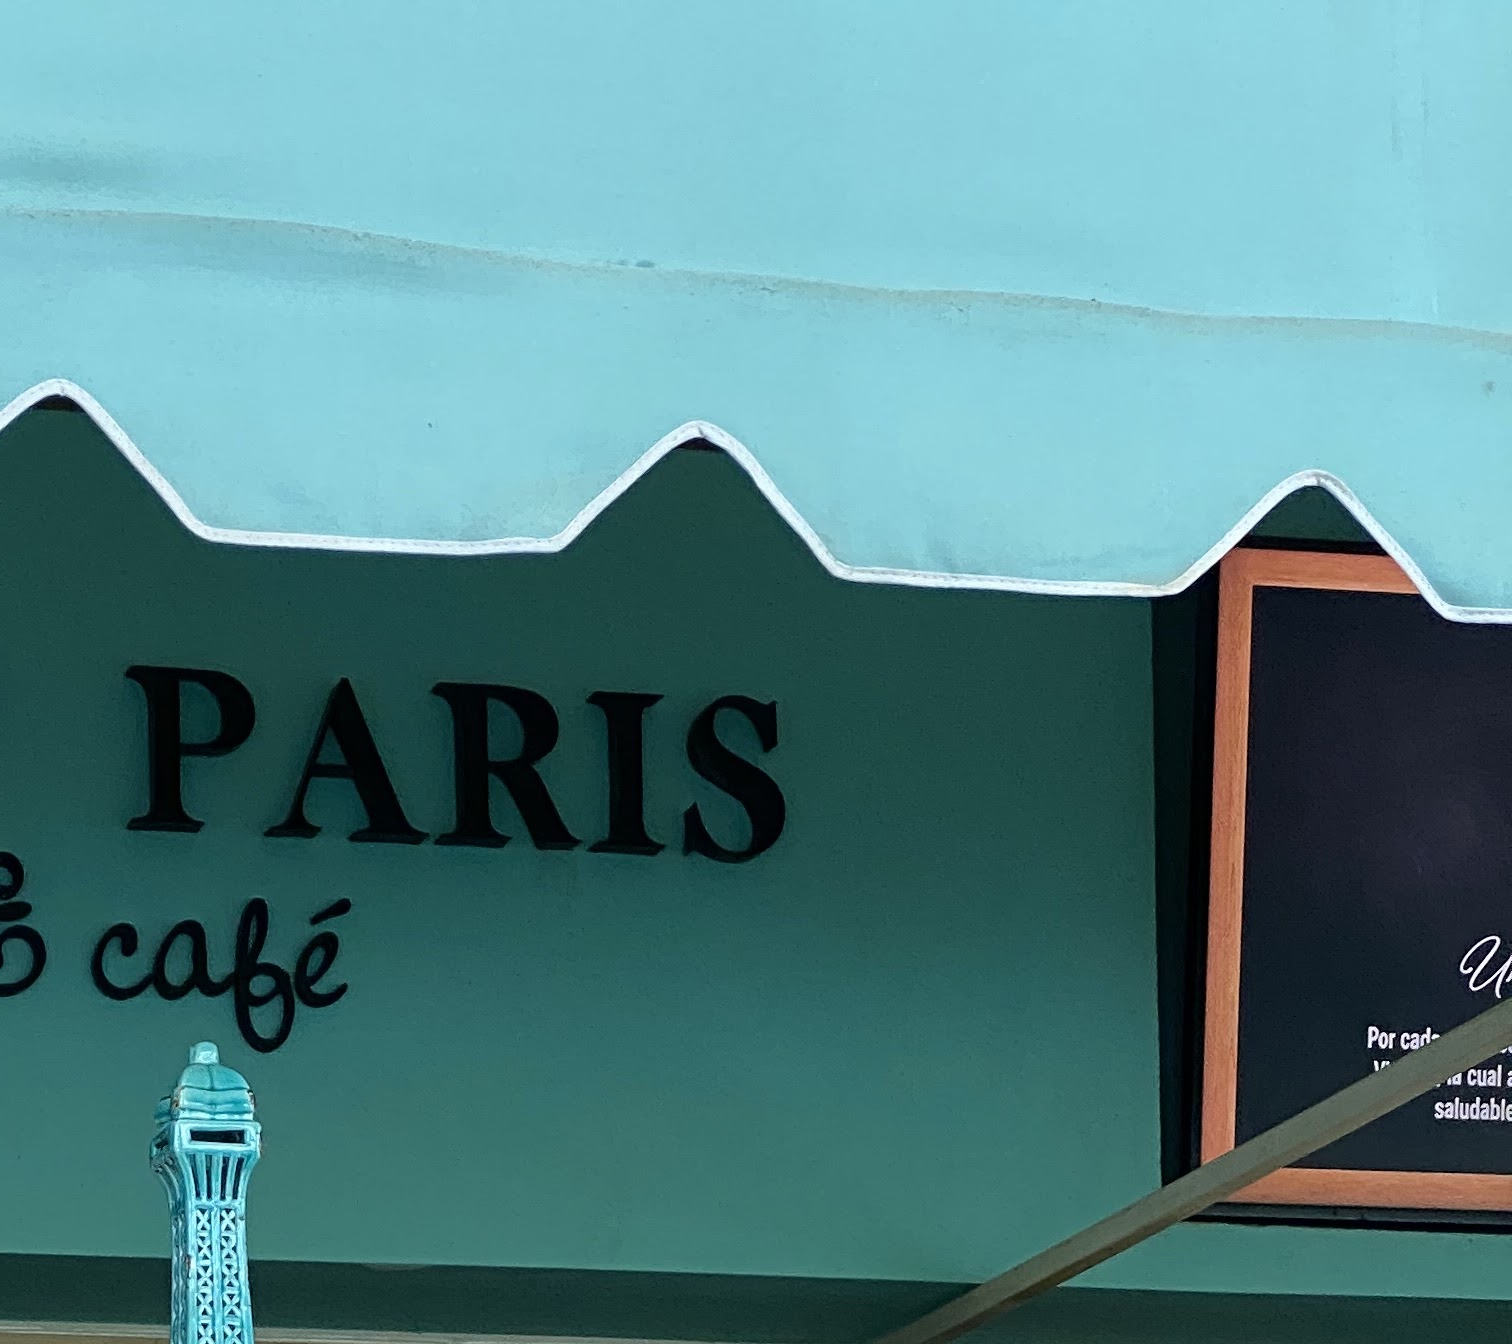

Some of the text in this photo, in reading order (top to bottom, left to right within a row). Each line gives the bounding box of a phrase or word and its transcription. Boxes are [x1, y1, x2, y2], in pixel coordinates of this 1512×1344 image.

[124, 664, 786, 864] PARIS
[89, 897, 353, 1054] café
[1367, 1025, 1441, 1050] Por cad
[1467, 1064, 1502, 1087] cual
